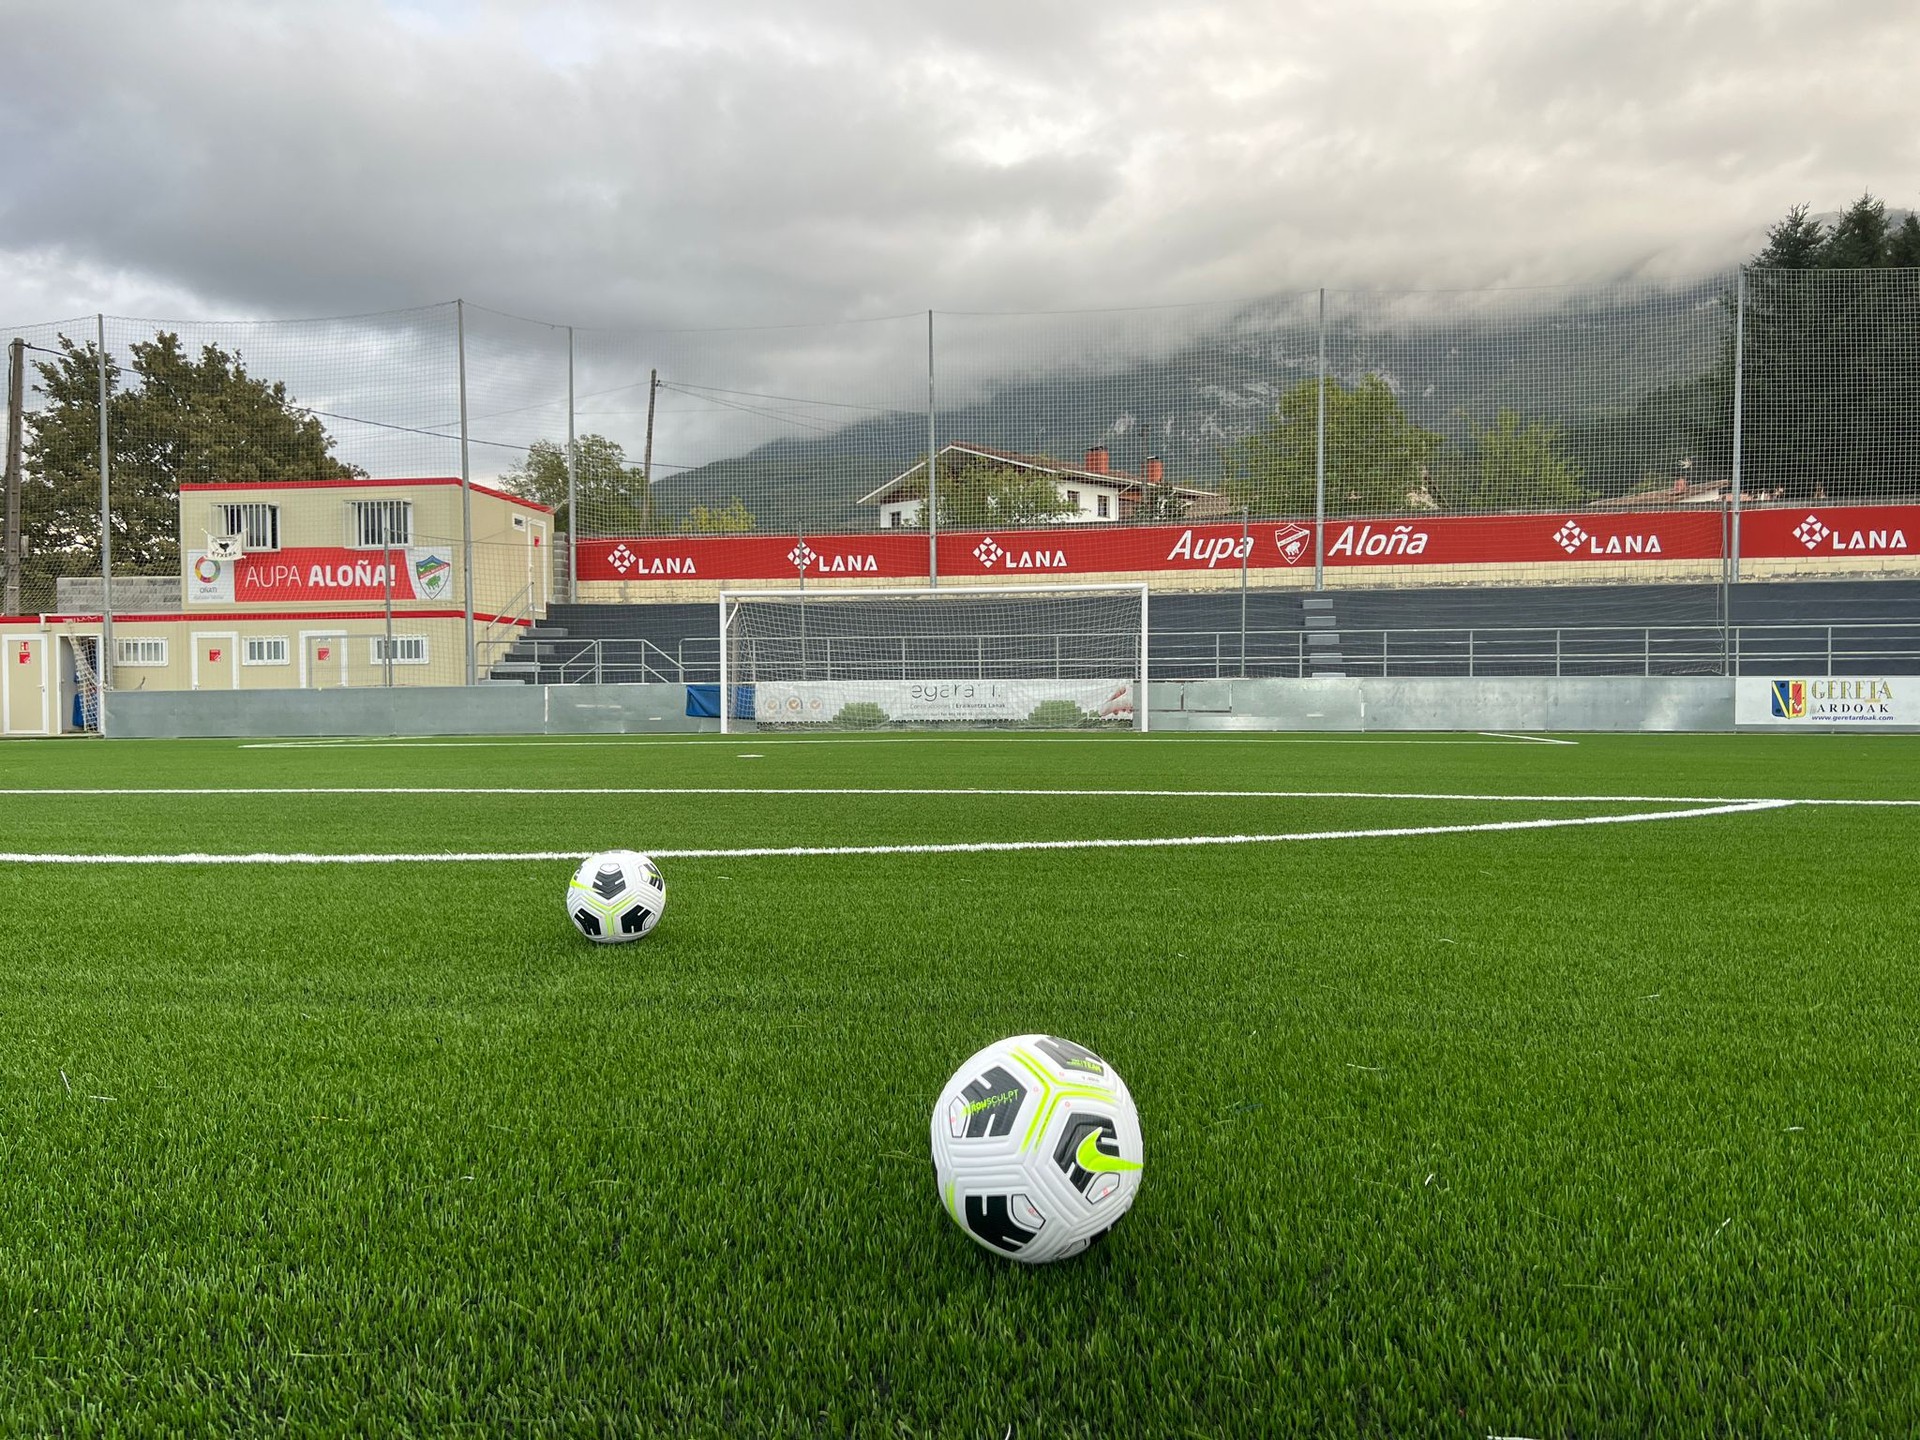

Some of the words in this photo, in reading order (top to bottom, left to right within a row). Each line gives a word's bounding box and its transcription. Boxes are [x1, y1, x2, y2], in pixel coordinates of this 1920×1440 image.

[1167, 530, 1255, 568] Aupa
[1327, 525, 1429, 557] Aloña
[1590, 534, 1662, 554] LANA
[1832, 529, 1908, 549] LANA
[637, 557, 697, 574] LANA
[818, 554, 879, 572] LANA
[1005, 550, 1068, 568] LANA
[245, 565, 302, 588] AUPA
[308, 559, 396, 588] ALOÑA!
[1811, 678, 1893, 700] GERETA
[1817, 703, 1889, 713] ARDOAK
[1811, 714, 1894, 722] www.geretardoak.com
